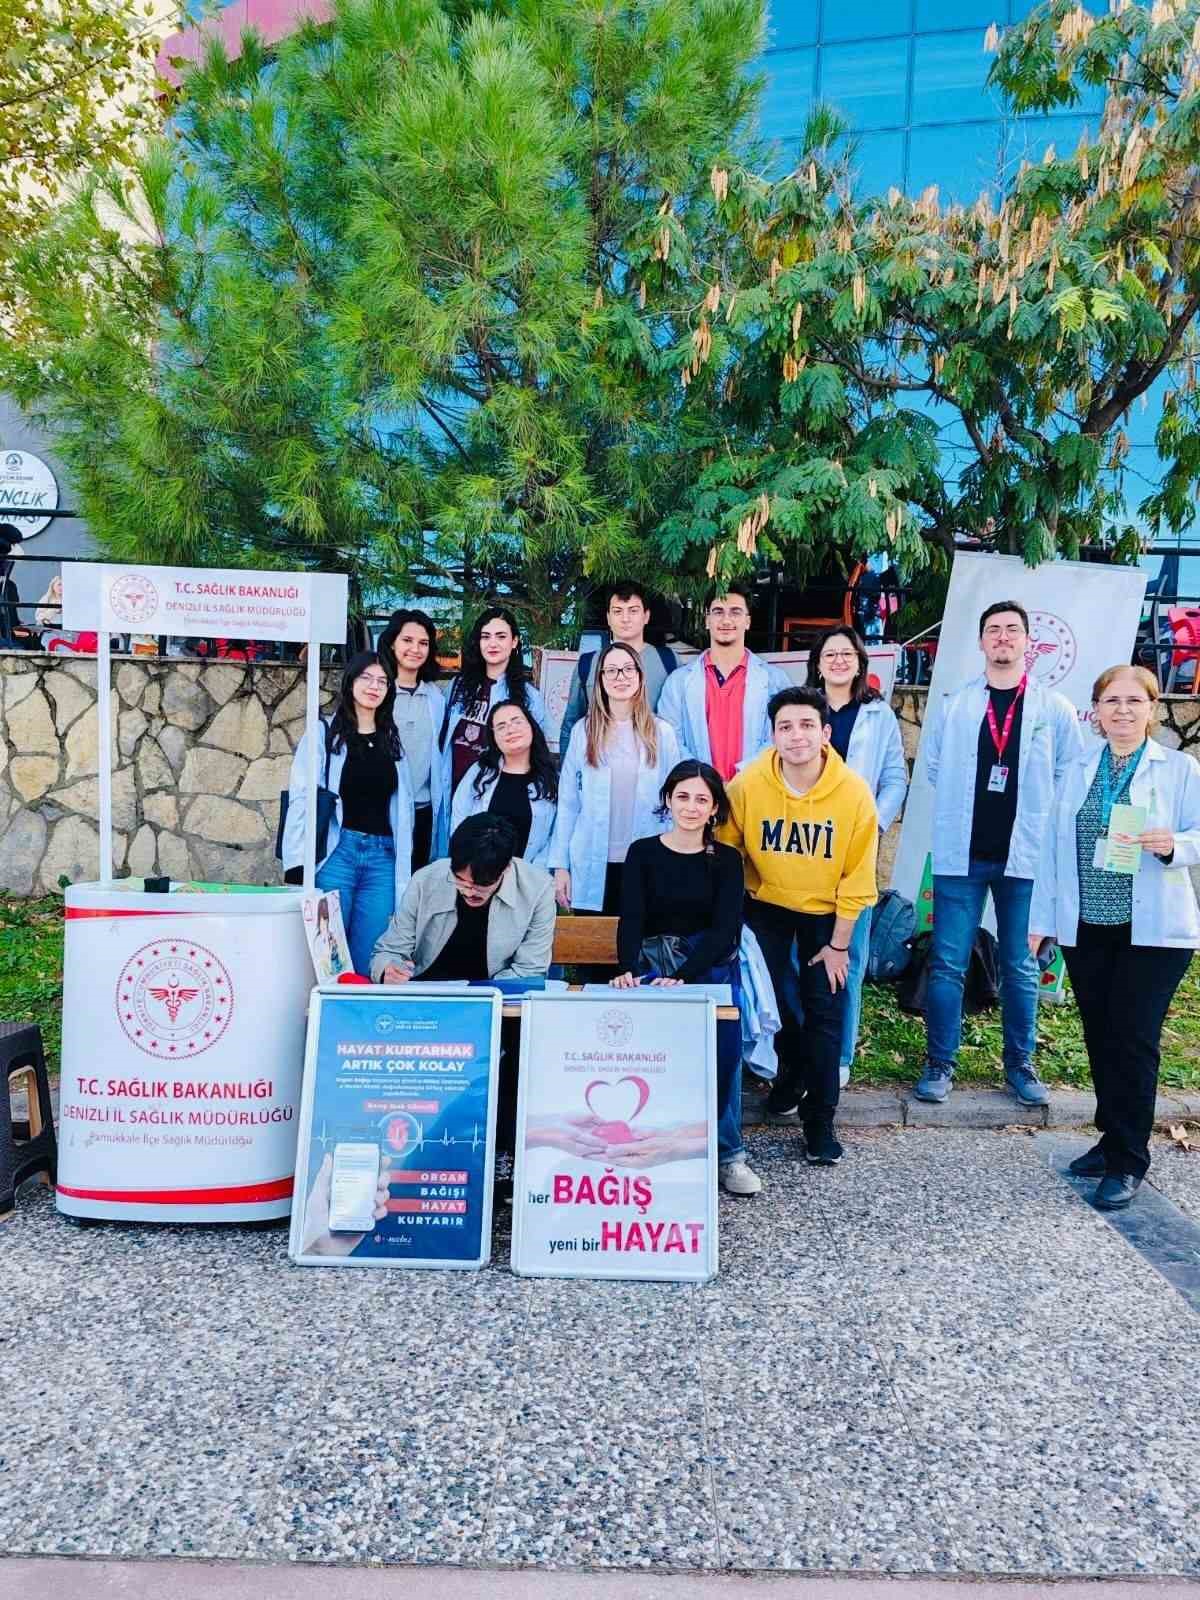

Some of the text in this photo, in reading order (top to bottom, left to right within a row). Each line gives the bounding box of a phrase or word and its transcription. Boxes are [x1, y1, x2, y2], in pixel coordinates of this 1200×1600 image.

[175, 582, 299, 599] T.C. SAĞLIK BAKANLIĞI
[760, 818, 834, 859] MAVİ
[337, 1044, 473, 1057] HAYAT KURTARMAK
[342, 1060, 465, 1073] ARTIK ÇOK KOLAY
[77, 1078, 273, 1099] T.C. SAĞLIK BAKANLIĞI
[63, 1104, 293, 1126] DENİZLİ İL SAĞLIK MÜDÜRLÜĞÜ
[420, 1173, 465, 1182] ORGAN
[420, 1186, 465, 1198] BAĞIŞI
[528, 1168, 653, 1215] her BAĞIŞ
[421, 1202, 465, 1211] HAYAT
[397, 1216, 464, 1226] KURTARIR
[549, 1221, 705, 1254] yeni bir HAYAT
